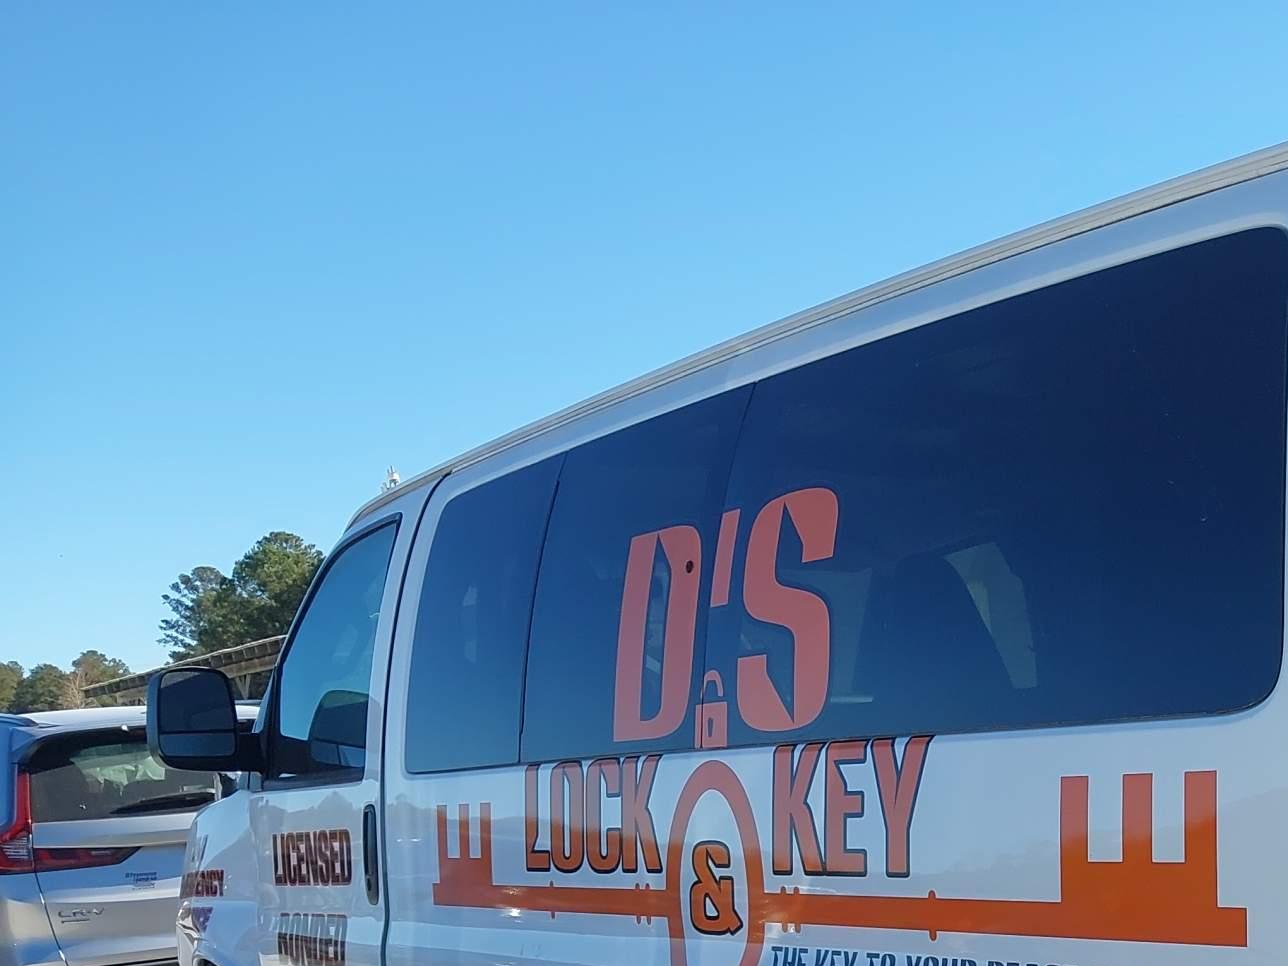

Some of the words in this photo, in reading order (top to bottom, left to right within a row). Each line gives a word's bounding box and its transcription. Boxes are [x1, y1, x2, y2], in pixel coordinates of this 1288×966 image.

[613, 487, 839, 743] D'S
[272, 828, 352, 888] LICENSED
[524, 754, 664, 875] LOCK
[690, 839, 744, 936] &
[771, 734, 936, 879] KEY
